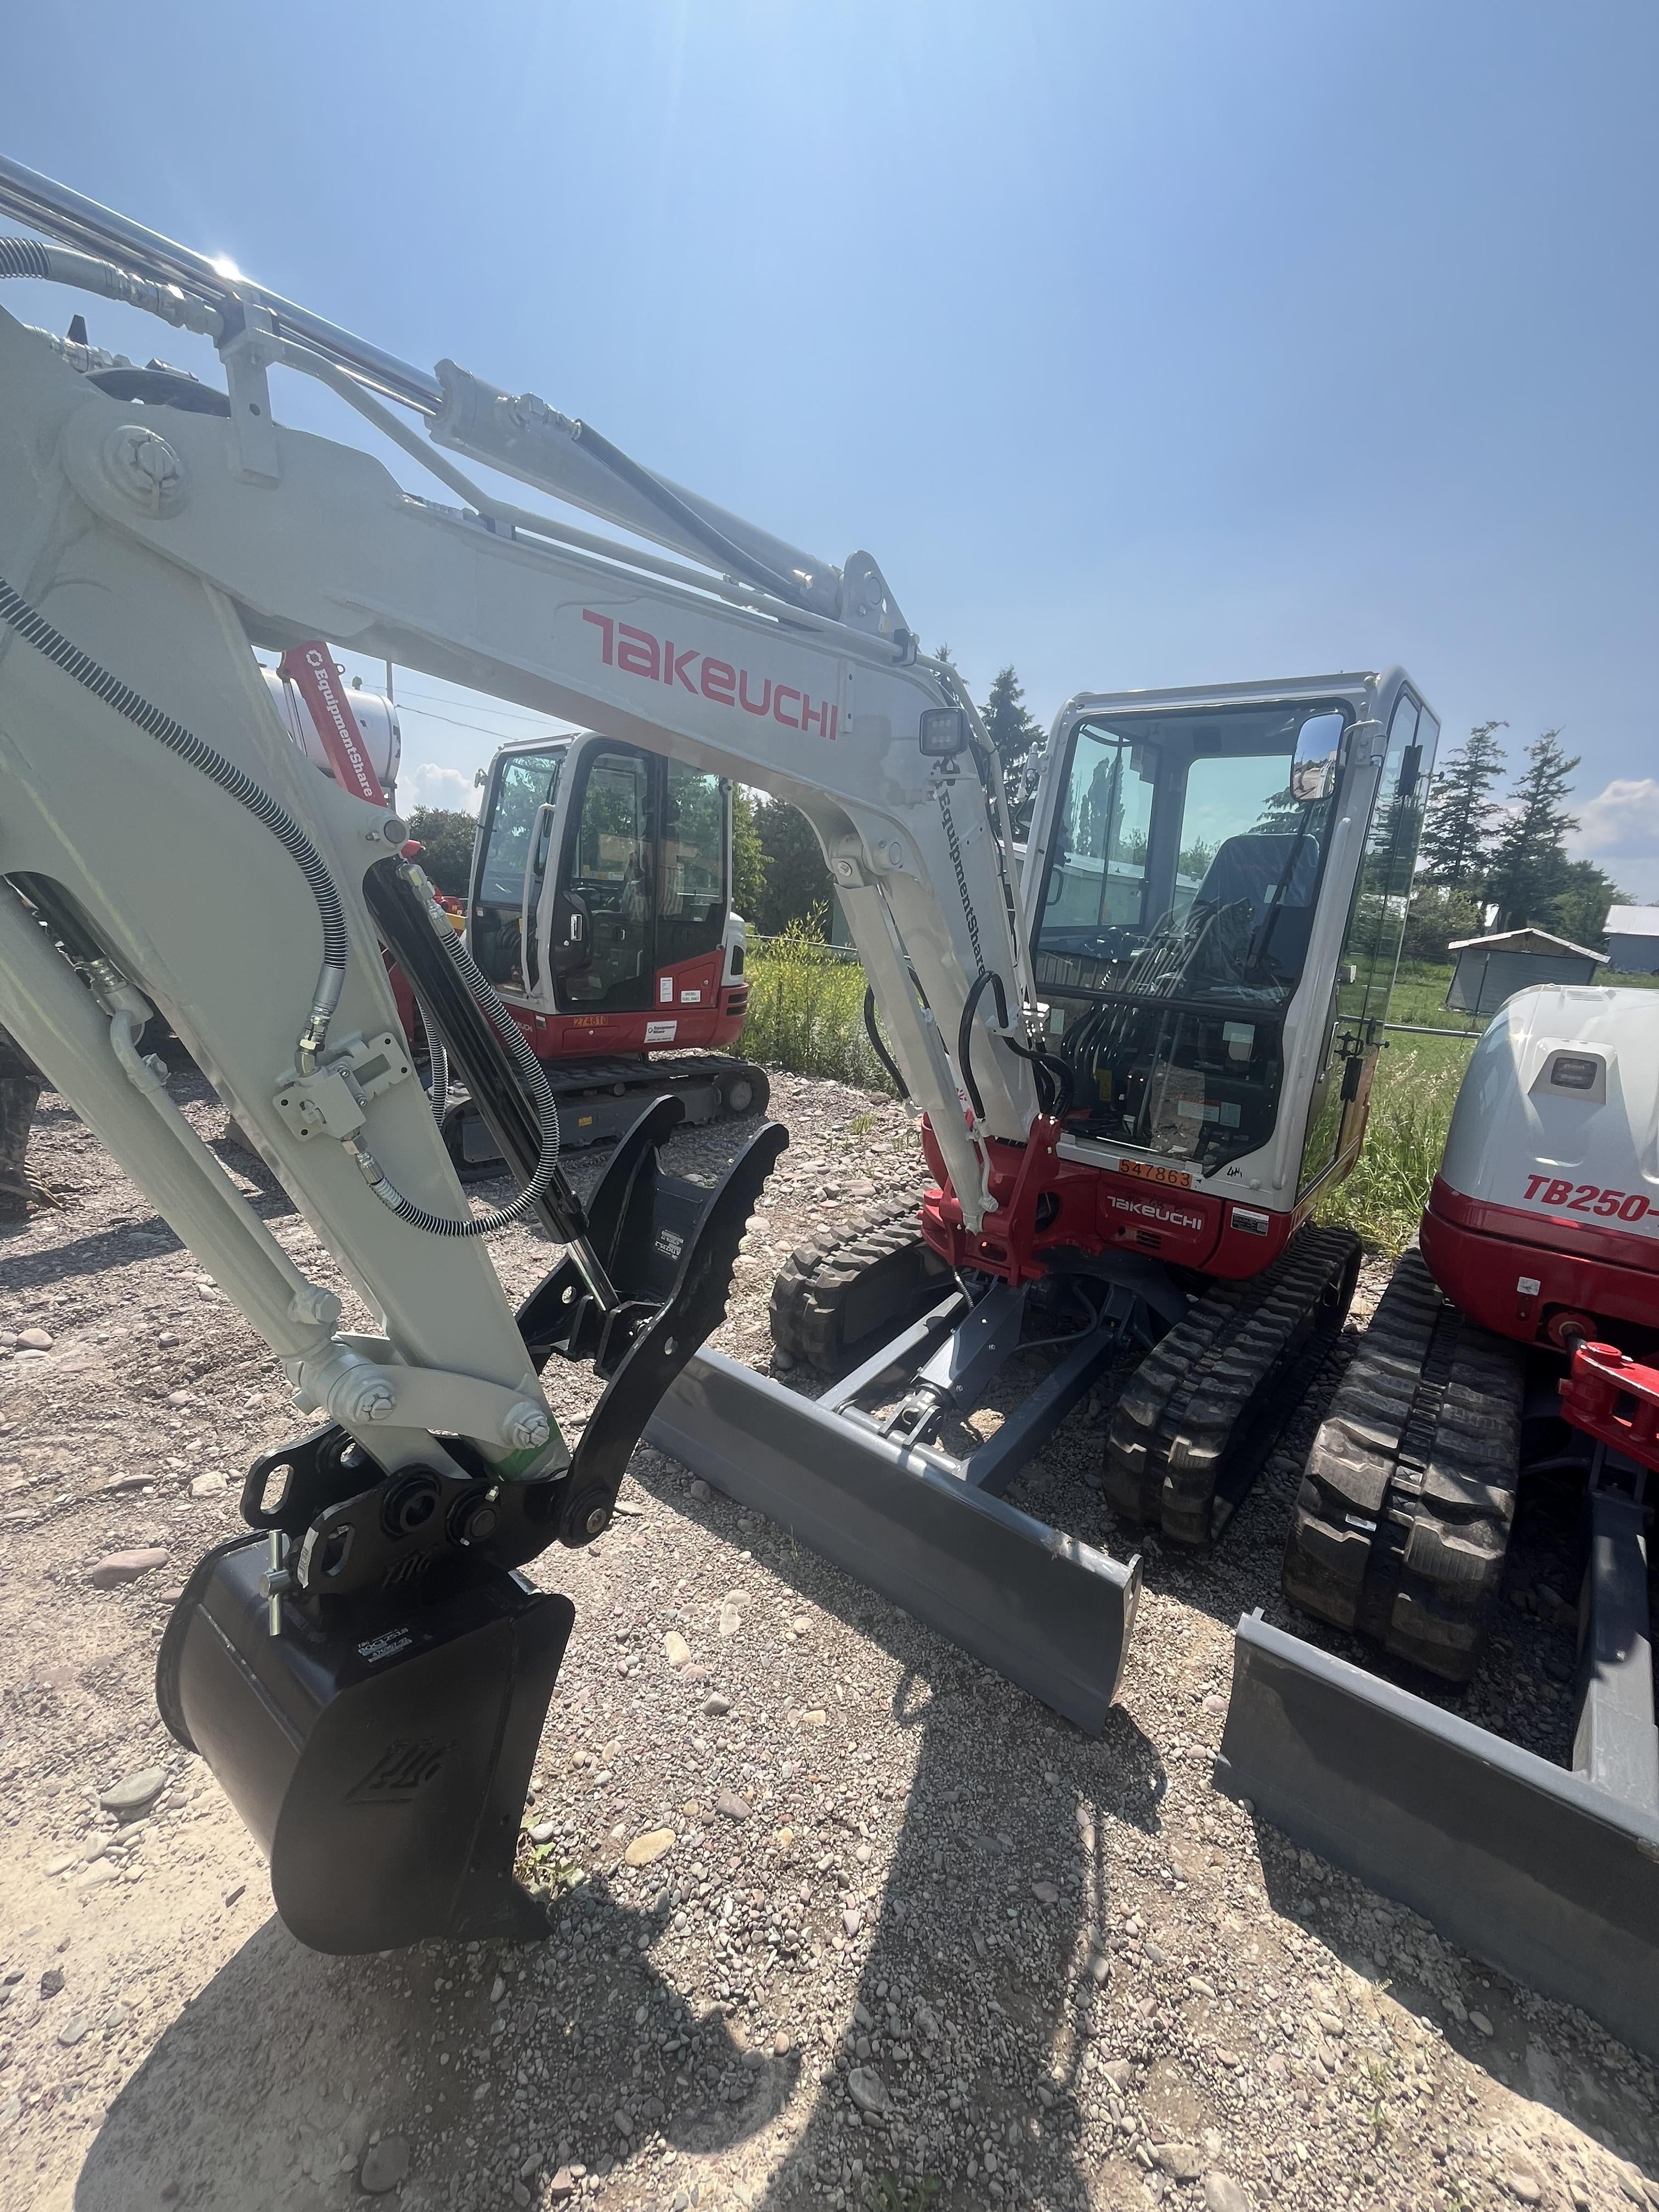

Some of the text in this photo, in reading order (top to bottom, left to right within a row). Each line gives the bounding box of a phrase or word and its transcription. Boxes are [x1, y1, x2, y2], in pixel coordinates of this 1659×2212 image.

[313, 668, 373, 797] EquipmentShare
[938, 788, 985, 977] EquipmentShare
[1120, 1159, 1190, 1187] 547863
